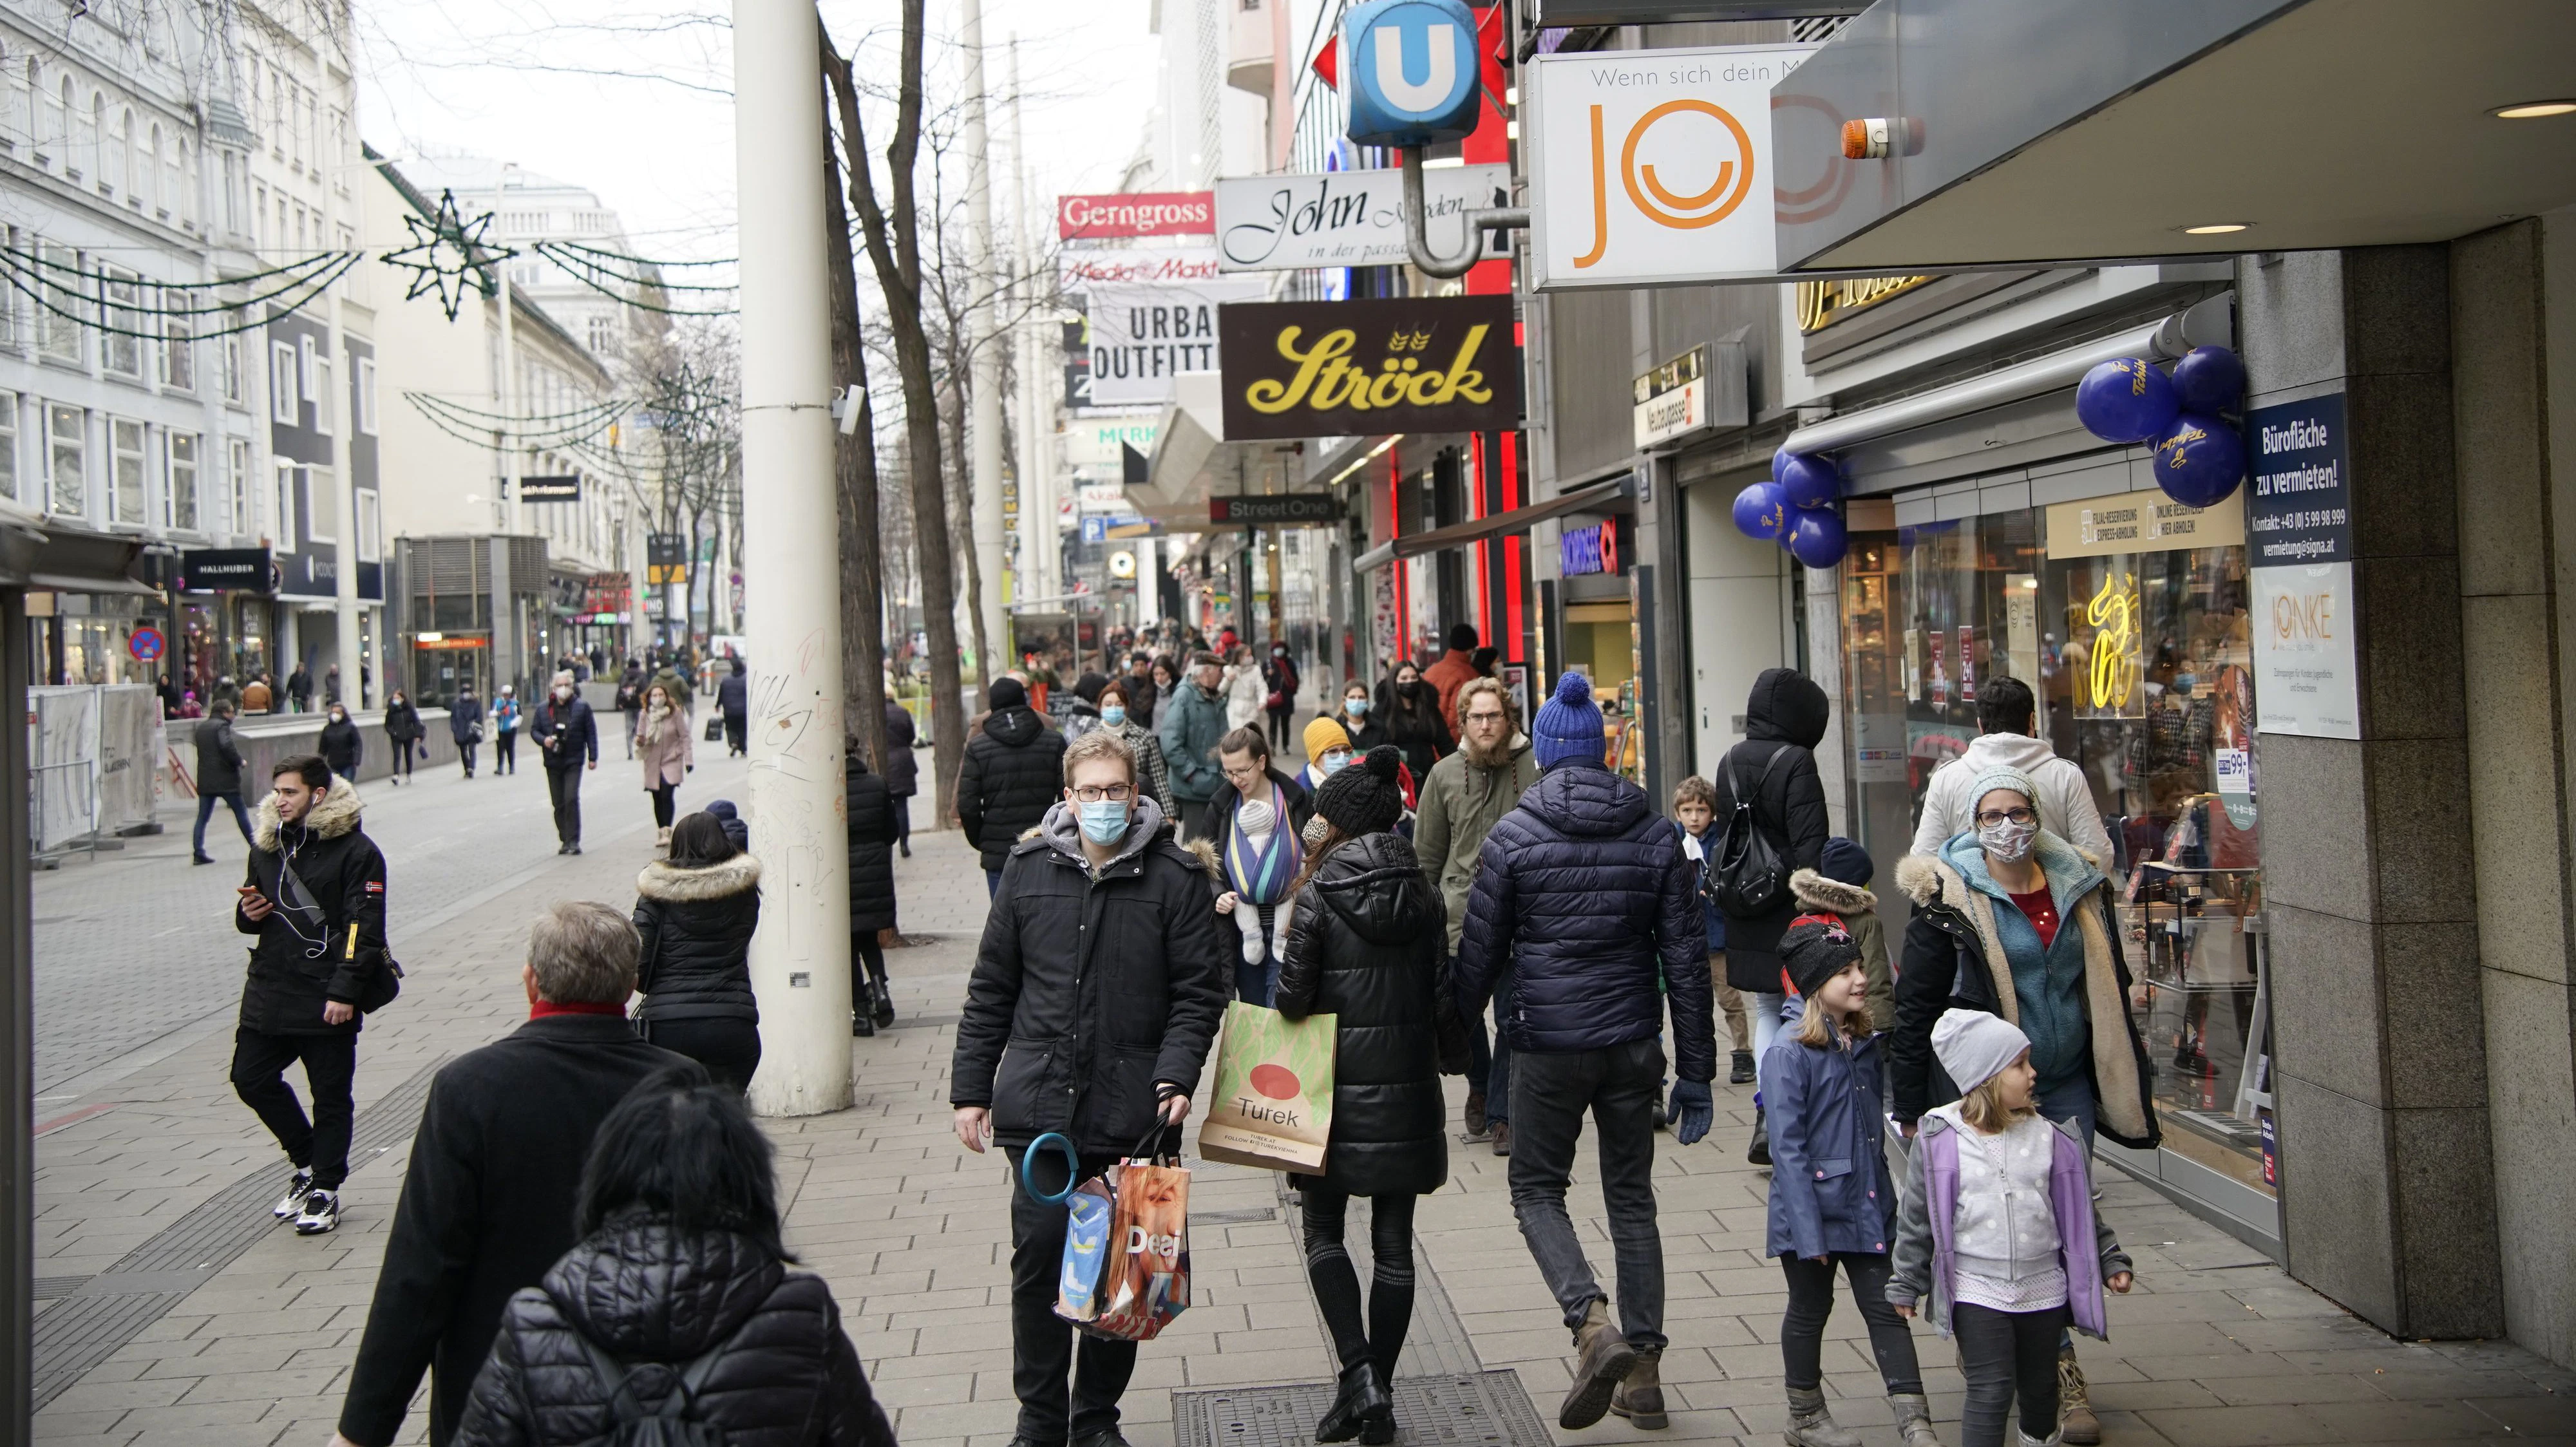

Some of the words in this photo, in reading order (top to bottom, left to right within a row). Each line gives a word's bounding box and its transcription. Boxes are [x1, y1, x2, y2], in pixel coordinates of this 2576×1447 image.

[1374, 24, 1455, 112] U
[1591, 68, 1658, 87] Wenn
[1670, 65, 1711, 84] sich
[1723, 62, 1770, 81] dein
[1064, 198, 1208, 232] Gerngross
[1223, 178, 1368, 264] John
[1307, 245, 1325, 258] in
[1331, 243, 1354, 257] der
[1063, 260, 1135, 282] Media
[1153, 258, 1218, 280] Markt
[1245, 324, 1493, 413] Ströck
[1647, 399, 1685, 435] Neubaugasse
[2262, 418, 2327, 455] Bürofläche
[2256, 475, 2270, 496] zu
[2272, 459, 2337, 494] vermieten!
[1229, 501, 1287, 518] Street
[1290, 500, 1329, 515] One
[2093, 508, 2137, 525] FILIAL-RESERVIERUNG
[2156, 505, 2173, 518] ONLINE
[1084, 522, 1101, 540] P
[2161, 522, 2172, 536] HIER
[2173, 520, 2195, 534] ABHOLEN!
[2252, 514, 2280, 532] Kontakt:
[2280, 513, 2294, 529] +43
[2295, 511, 2304, 531] (0)
[2305, 512, 2310, 528] 5
[2311, 511, 2319, 527] 99
[2321, 510, 2330, 526] 98
[2331, 509, 2345, 525] 999
[2097, 525, 2137, 542] EXPRESS-ABHOLUNG
[2263, 538, 2335, 559] vermietung@signa.at
[200, 564, 254, 574] HALLHUBER
[2273, 594, 2331, 650] JONKE
[1962, 661, 1973, 681] 2+1
[1238, 1097, 1299, 1127] Turek
[1225, 1135, 1249, 1144] FOLLOW
[1260, 1143, 1298, 1154] TUREKVIENNA
[1251, 1134, 1276, 1144] TUREK.AT
